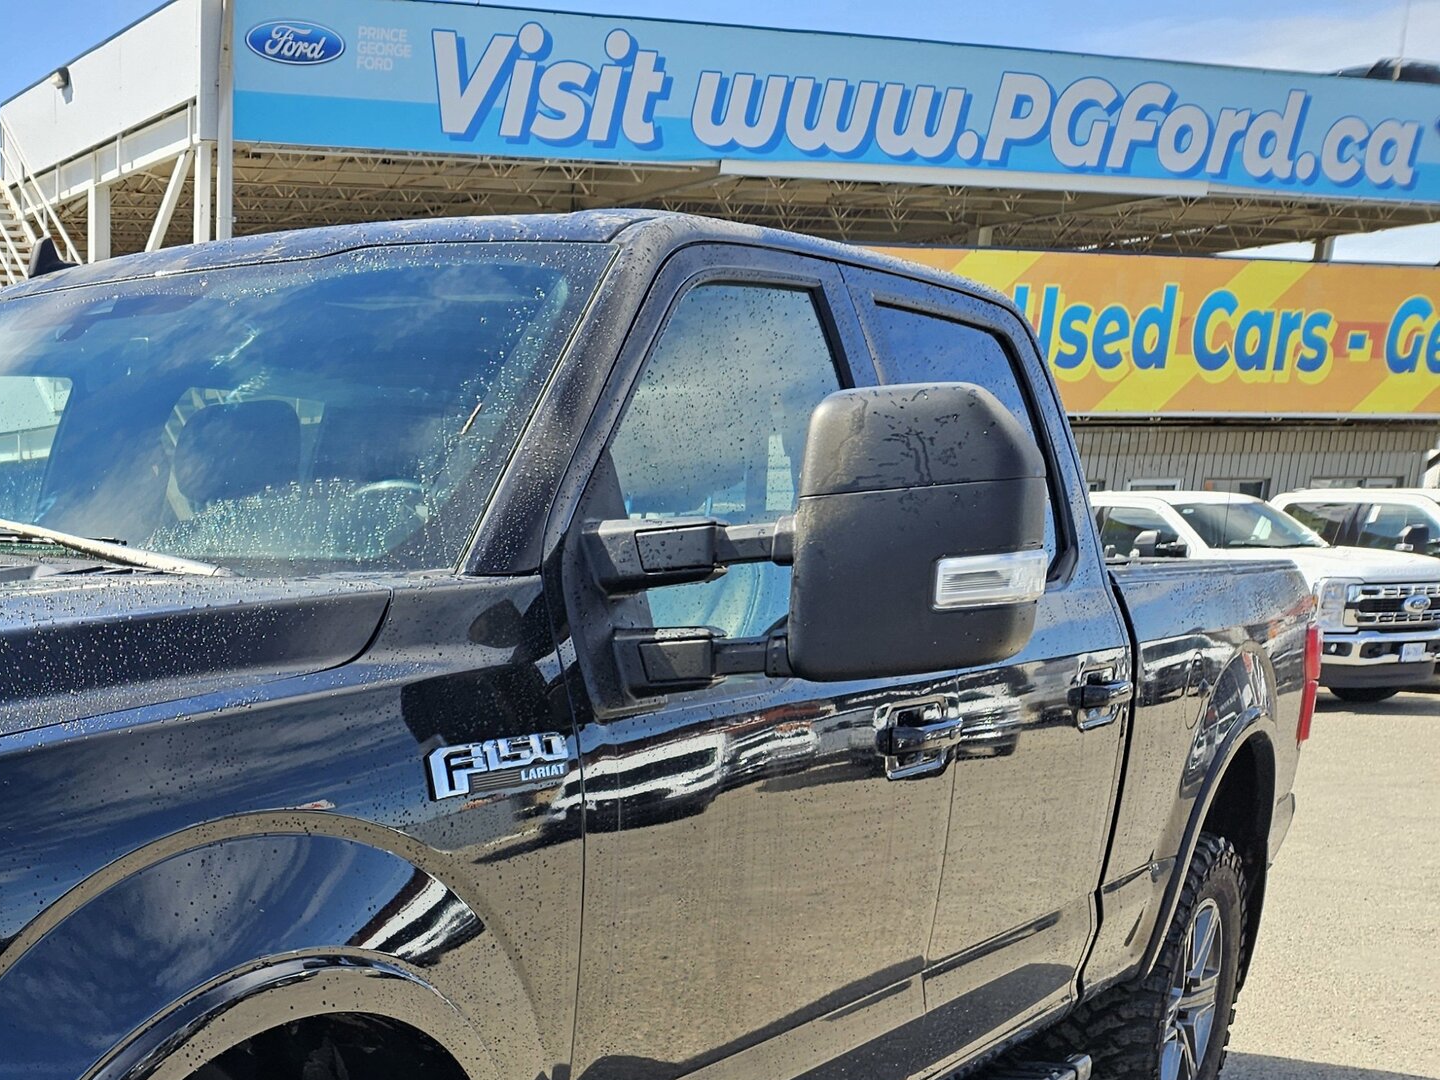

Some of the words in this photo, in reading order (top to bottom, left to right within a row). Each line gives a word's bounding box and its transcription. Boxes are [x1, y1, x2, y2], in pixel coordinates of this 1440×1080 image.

[265, 25, 326, 59] Ford
[357, 26, 408, 42] PRINCE
[356, 41, 413, 58] GEORGE
[356, 56, 393, 71] FORD
[431, 21, 668, 144] Visit
[1191, 288, 1333, 373] Cars
[520, 763, 565, 781] LARIAT
